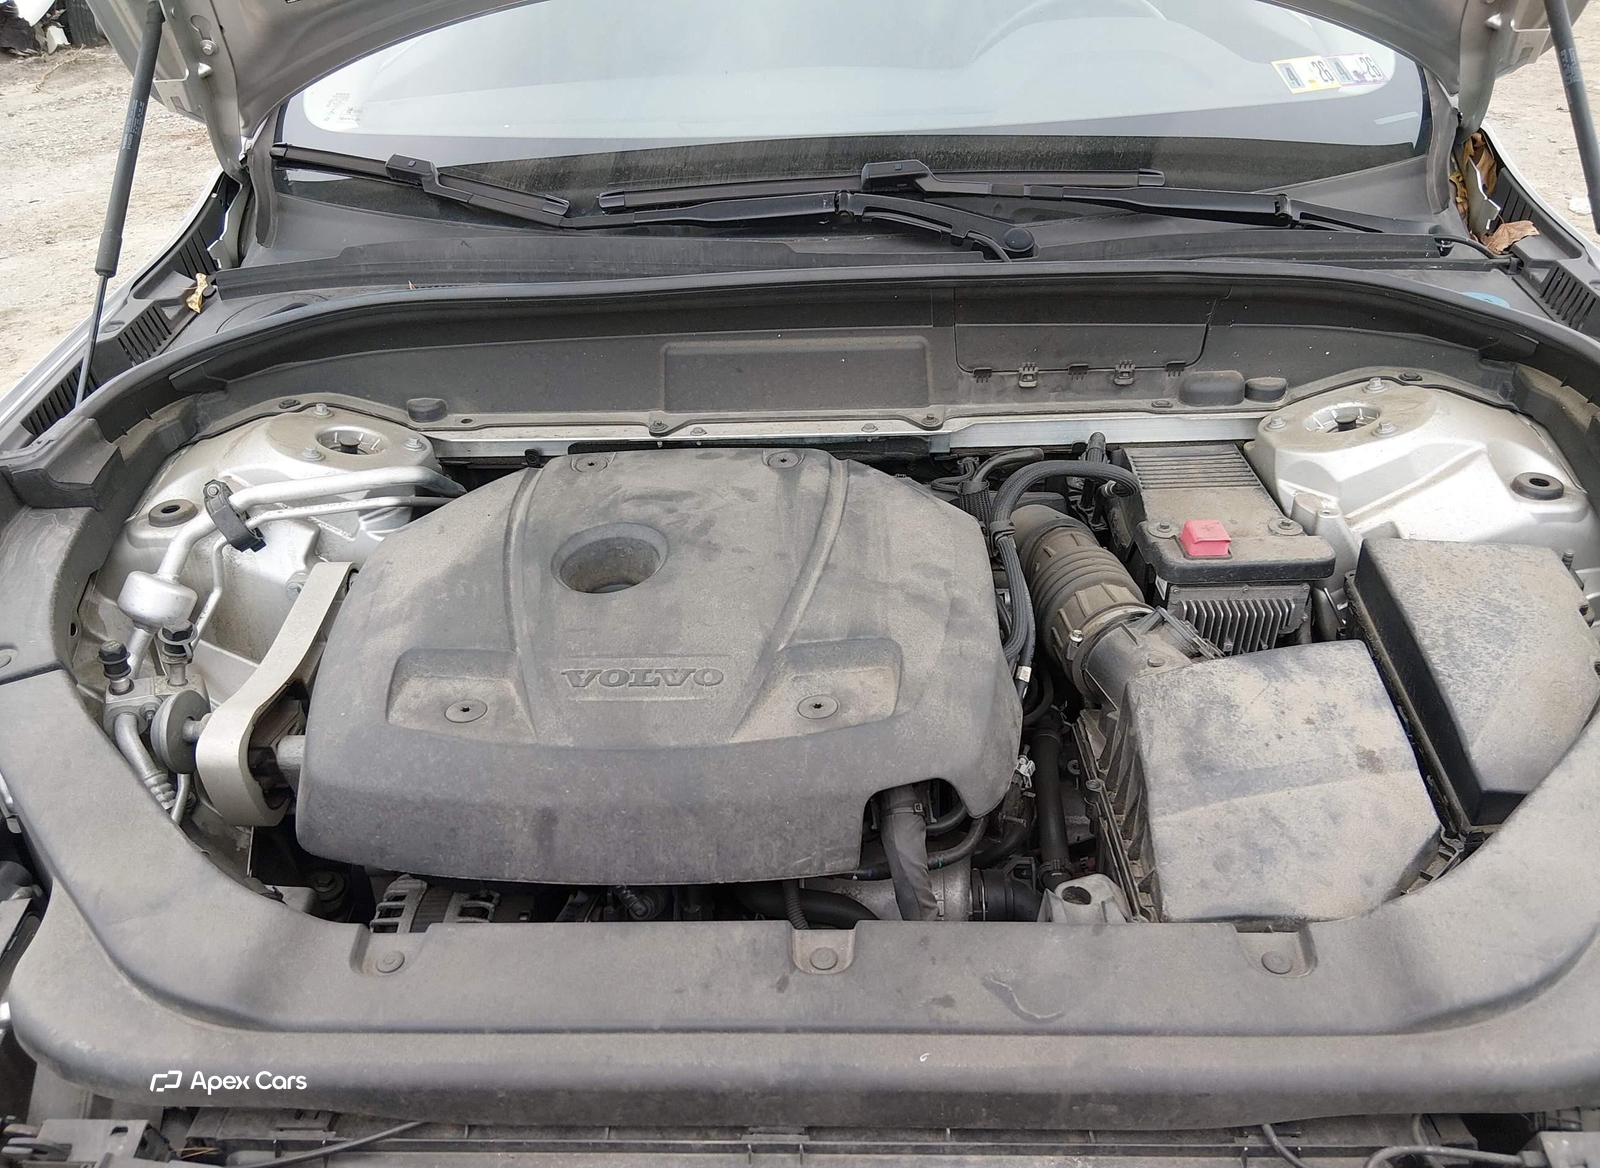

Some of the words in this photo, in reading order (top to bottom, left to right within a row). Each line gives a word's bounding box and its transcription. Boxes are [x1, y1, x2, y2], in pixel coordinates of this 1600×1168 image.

[1311, 60, 1335, 83] 26
[1358, 56, 1382, 79] 26
[561, 668, 724, 688] VOLVO
